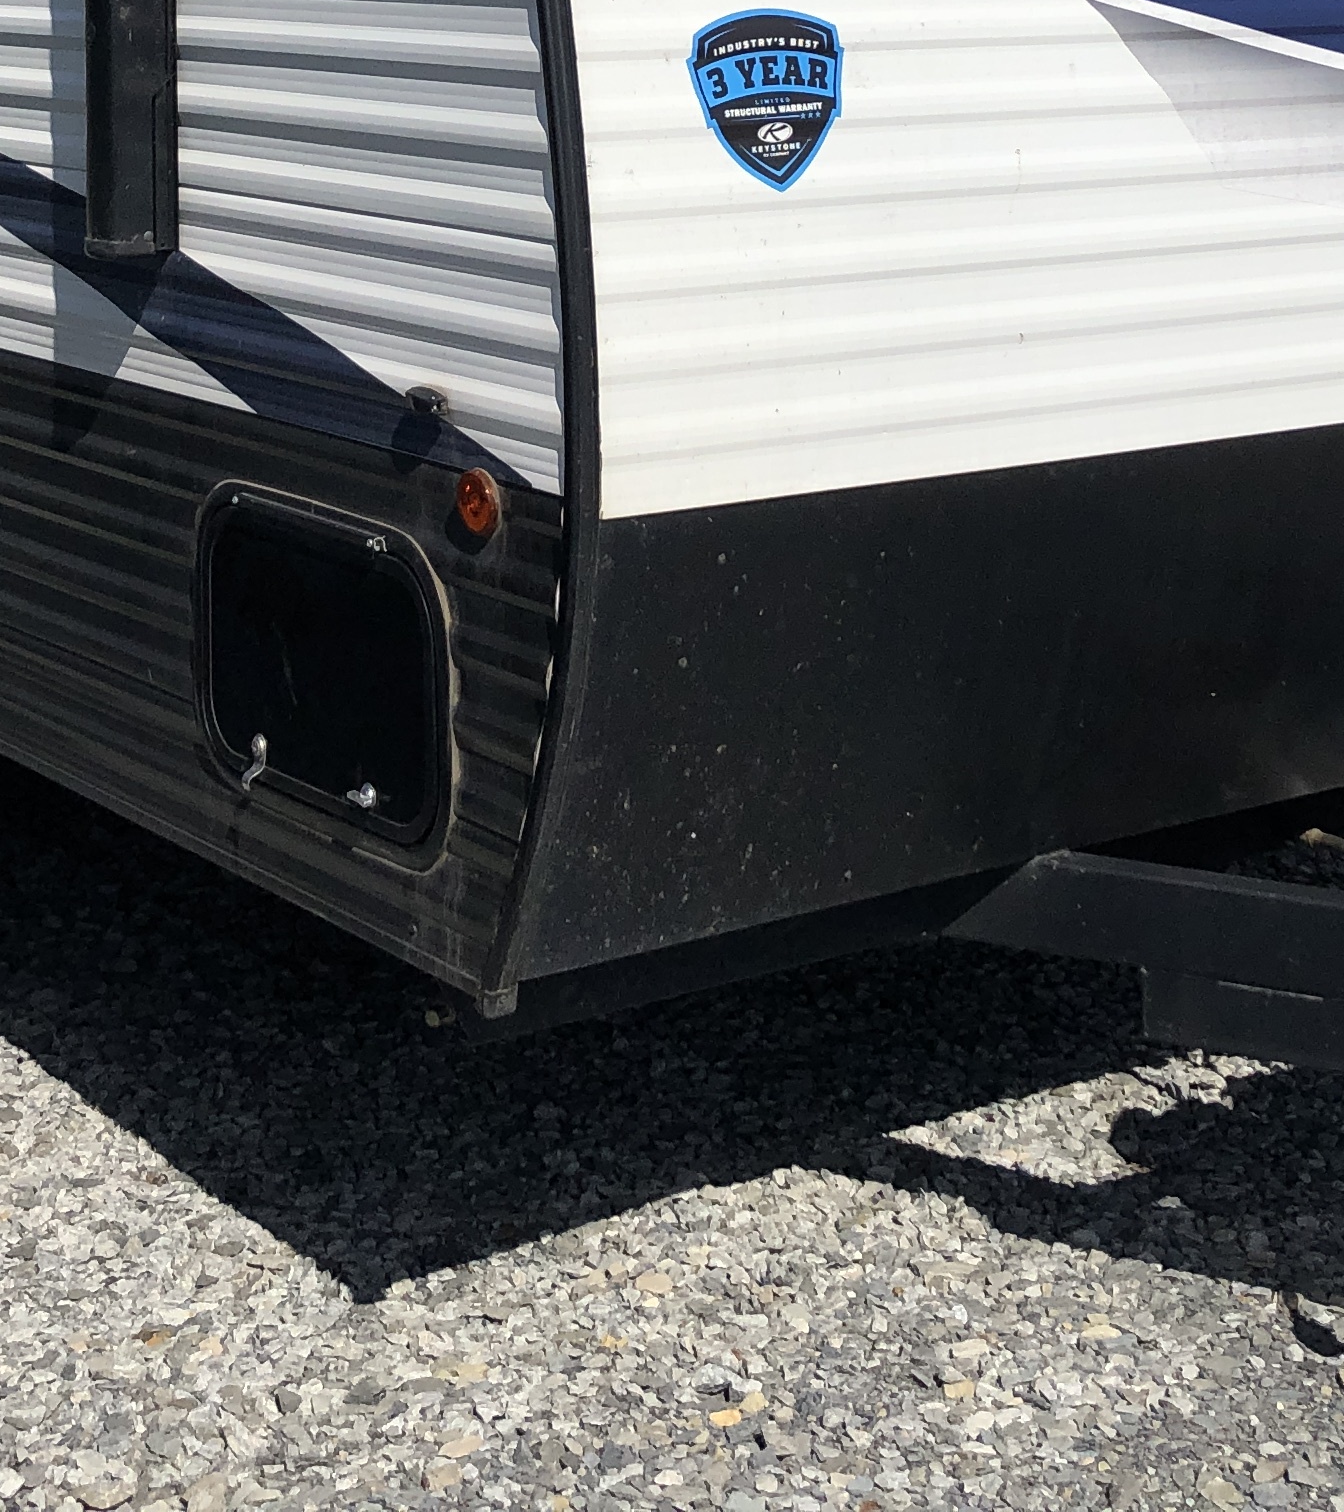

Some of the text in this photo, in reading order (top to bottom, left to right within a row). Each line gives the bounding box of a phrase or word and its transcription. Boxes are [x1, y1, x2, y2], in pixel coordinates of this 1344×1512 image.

[713, 37, 819, 57] INDUSTRY'S BEST
[706, 54, 829, 100] 3 YEAR
[724, 101, 823, 118] STRUCTURAL WARRANTY
[751, 142, 801, 154] KEYSTONE
